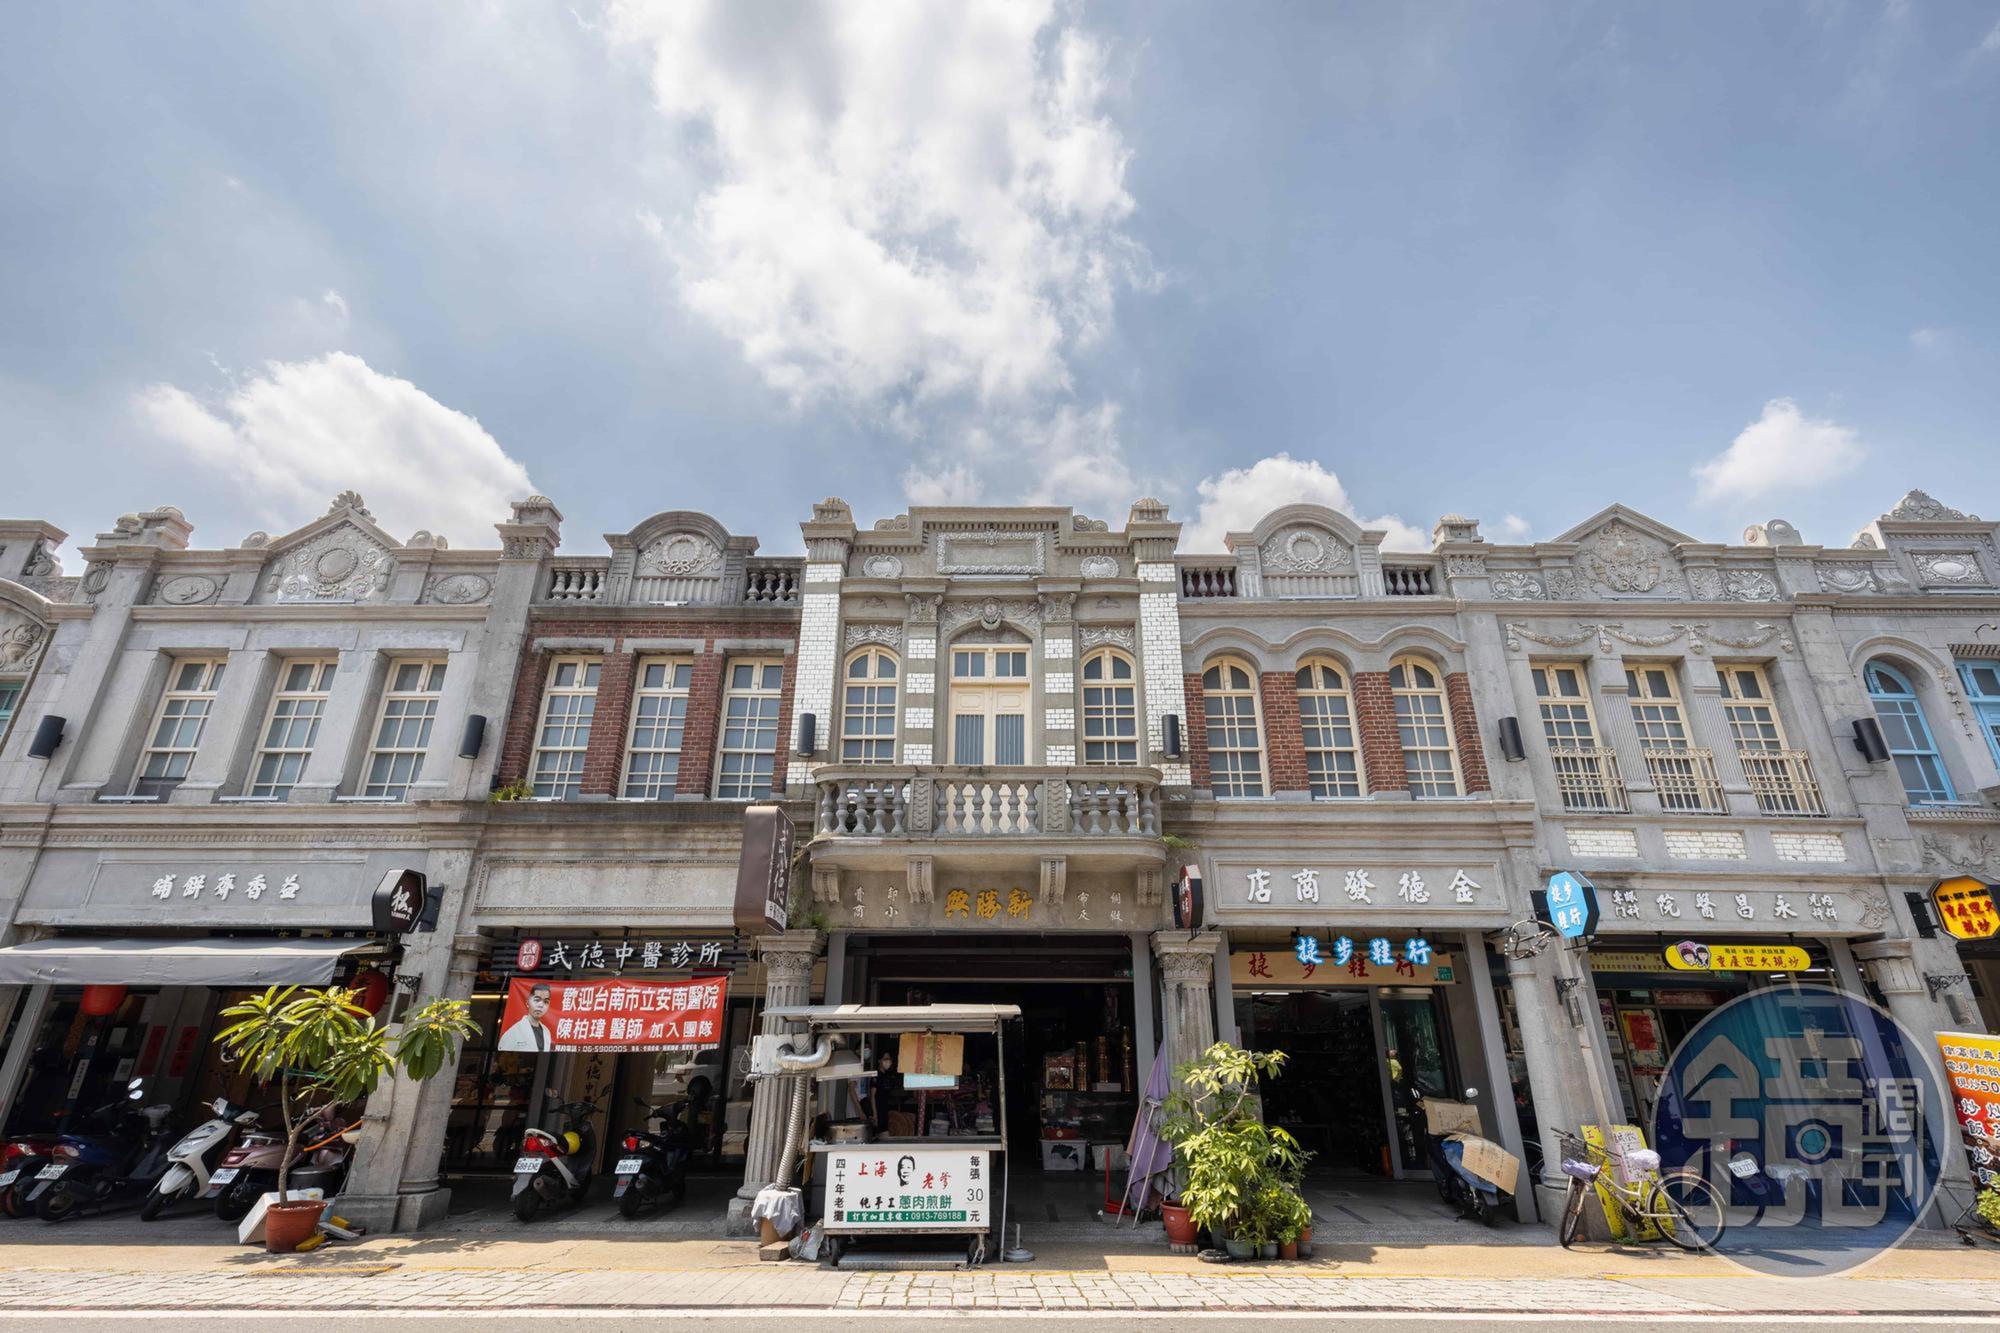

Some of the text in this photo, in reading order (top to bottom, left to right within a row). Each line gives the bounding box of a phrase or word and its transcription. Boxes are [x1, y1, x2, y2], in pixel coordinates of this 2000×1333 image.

[549, 941, 722, 970] 武德中醫診所
[1296, 936, 1432, 965] 捷步鞋行
[562, 985, 719, 1012] 歡迎台南市立安南醫院
[609, 1017, 644, 1040] 醫師
[649, 1020, 713, 1038] 加入團隊
[1961, 1099, 1986, 1137] 炒飯
[858, 1161, 887, 1178] 上海
[833, 1158, 846, 1222] 四十年老攤
[967, 1155, 984, 1222] 每張 30 元
